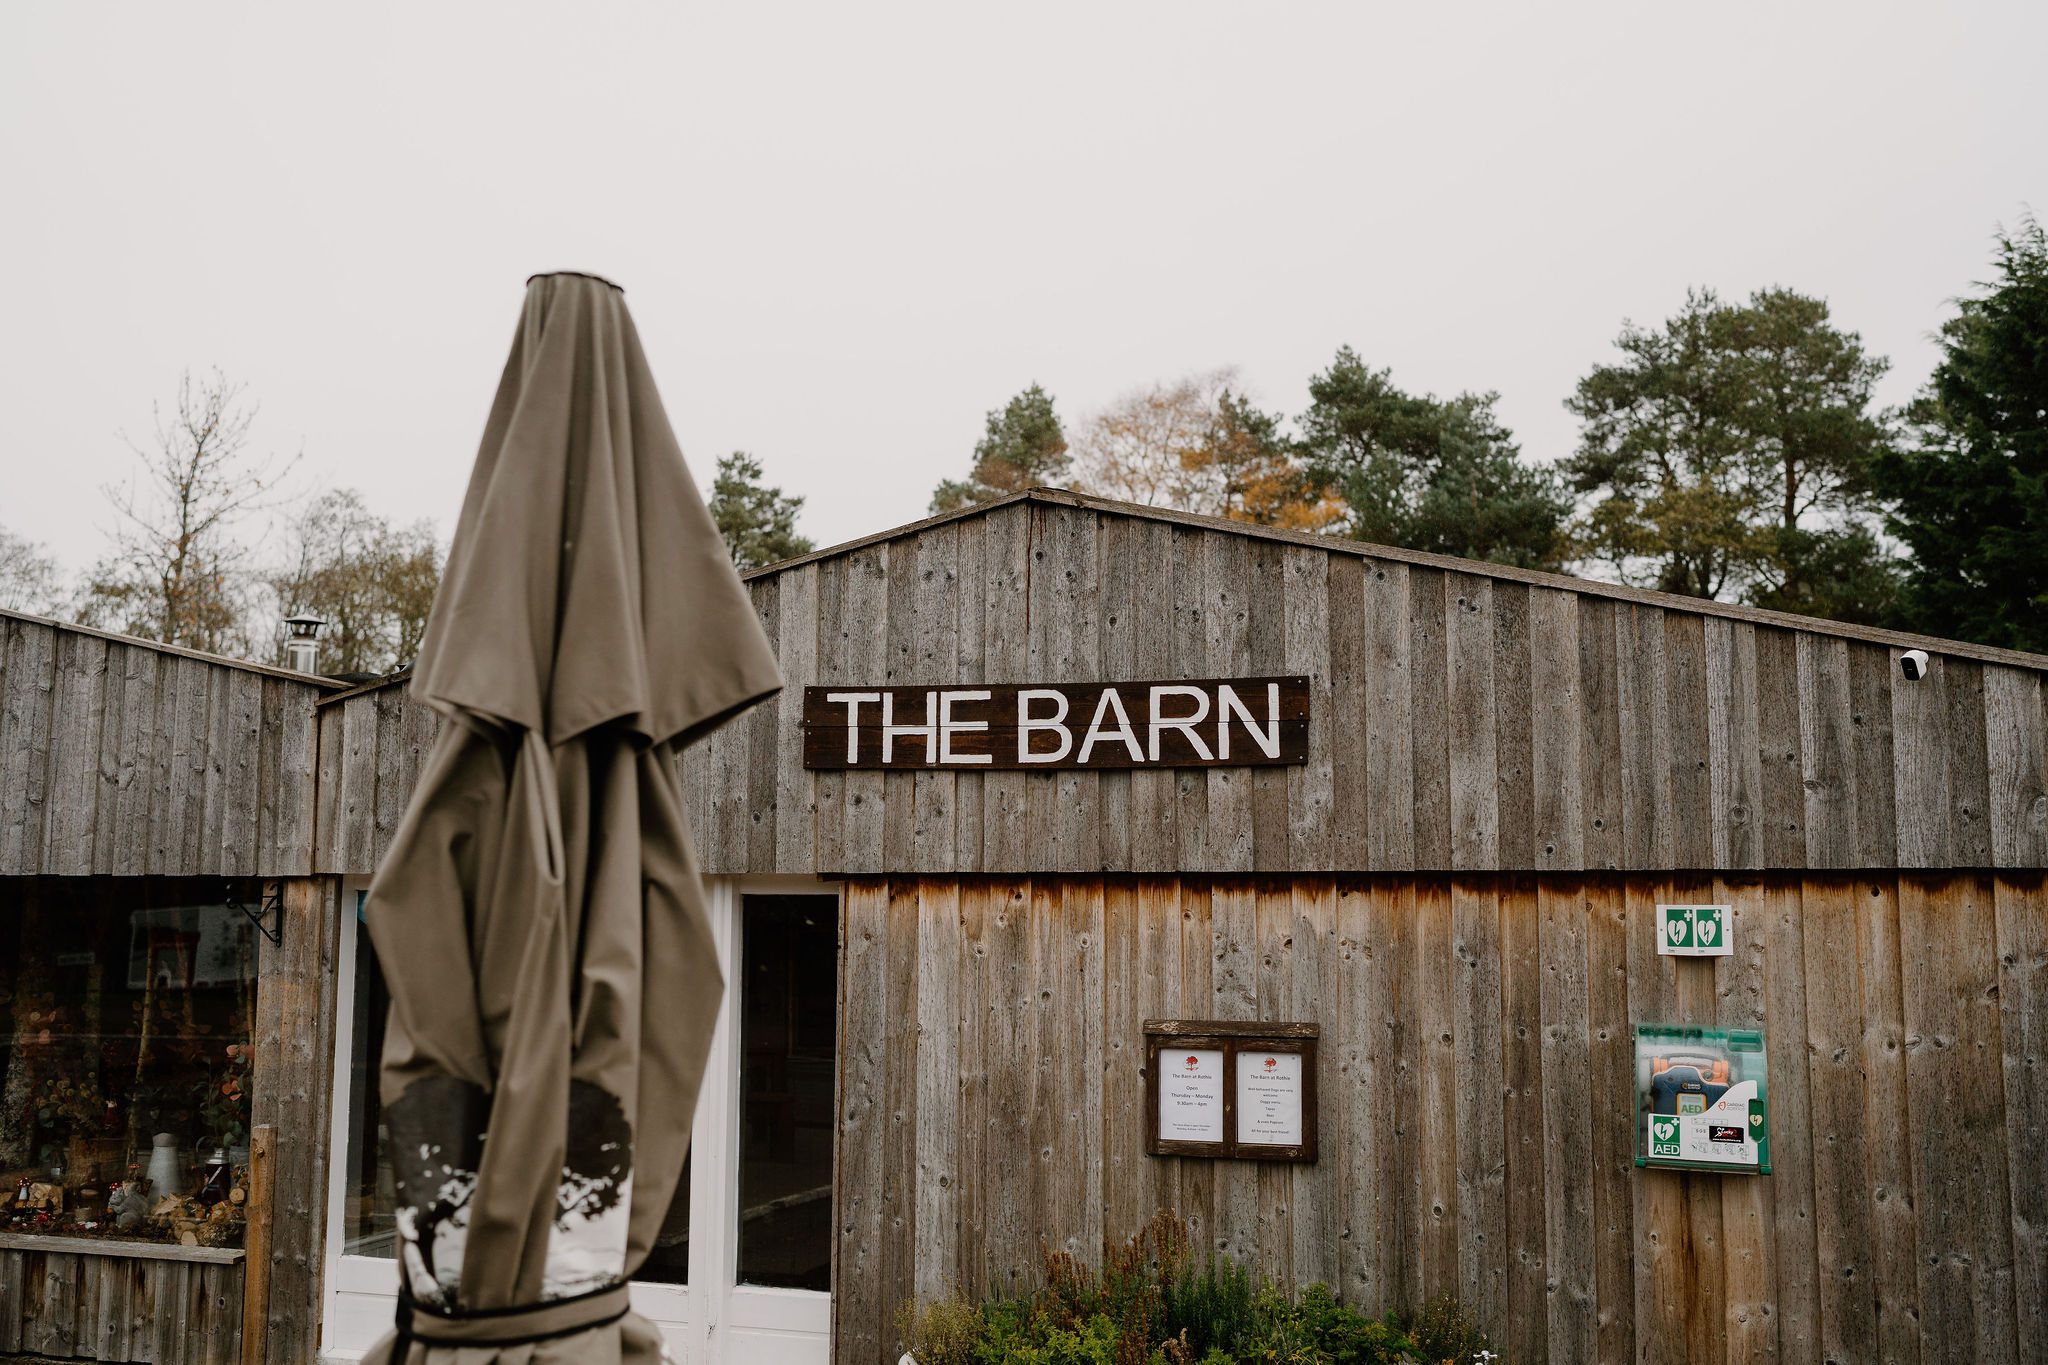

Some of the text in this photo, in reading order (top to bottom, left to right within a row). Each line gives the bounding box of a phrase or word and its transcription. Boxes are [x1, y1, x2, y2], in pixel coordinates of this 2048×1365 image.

[826, 682, 1280, 764] THE BARN
[1681, 1104, 1702, 1113] AED
[1654, 1144, 1680, 1155] AED
